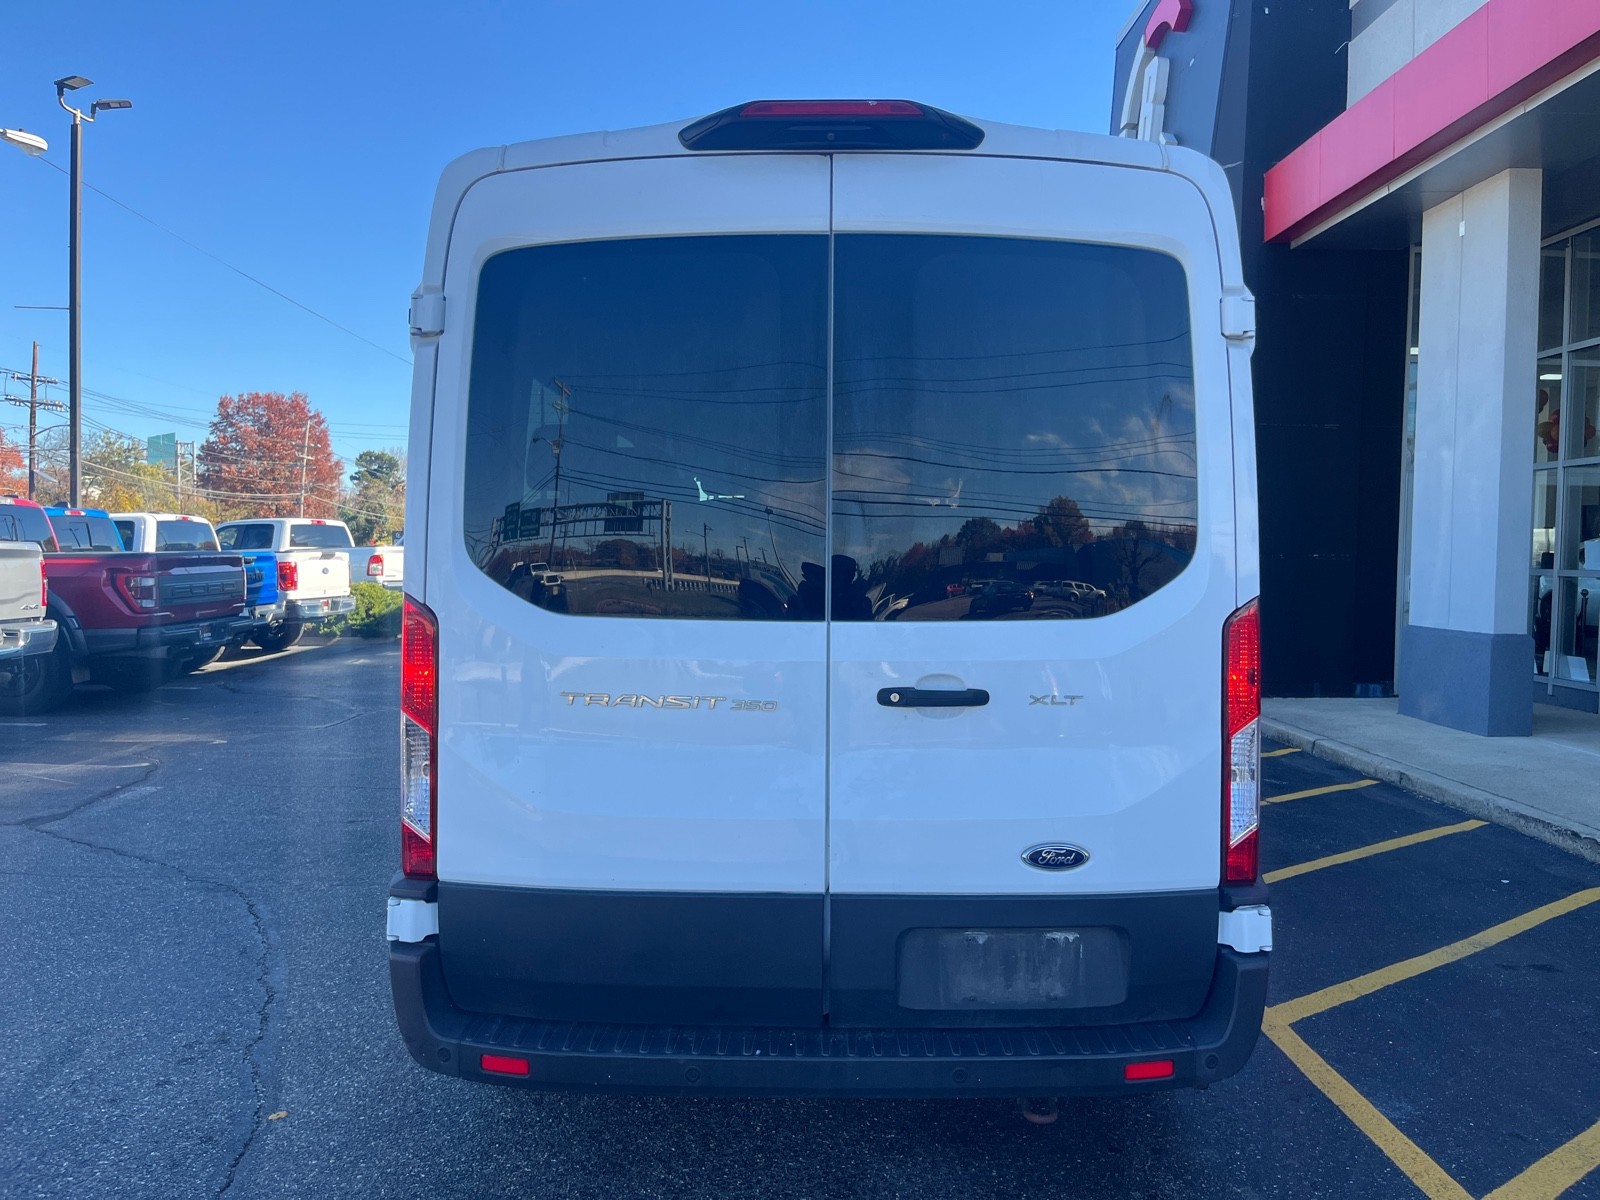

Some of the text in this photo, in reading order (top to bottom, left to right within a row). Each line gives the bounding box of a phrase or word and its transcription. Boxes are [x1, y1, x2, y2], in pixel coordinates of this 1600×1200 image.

[560, 690, 778, 712] TRANSIT 350
[1028, 694, 1084, 706] XLT
[1038, 848, 1076, 865] Ford
